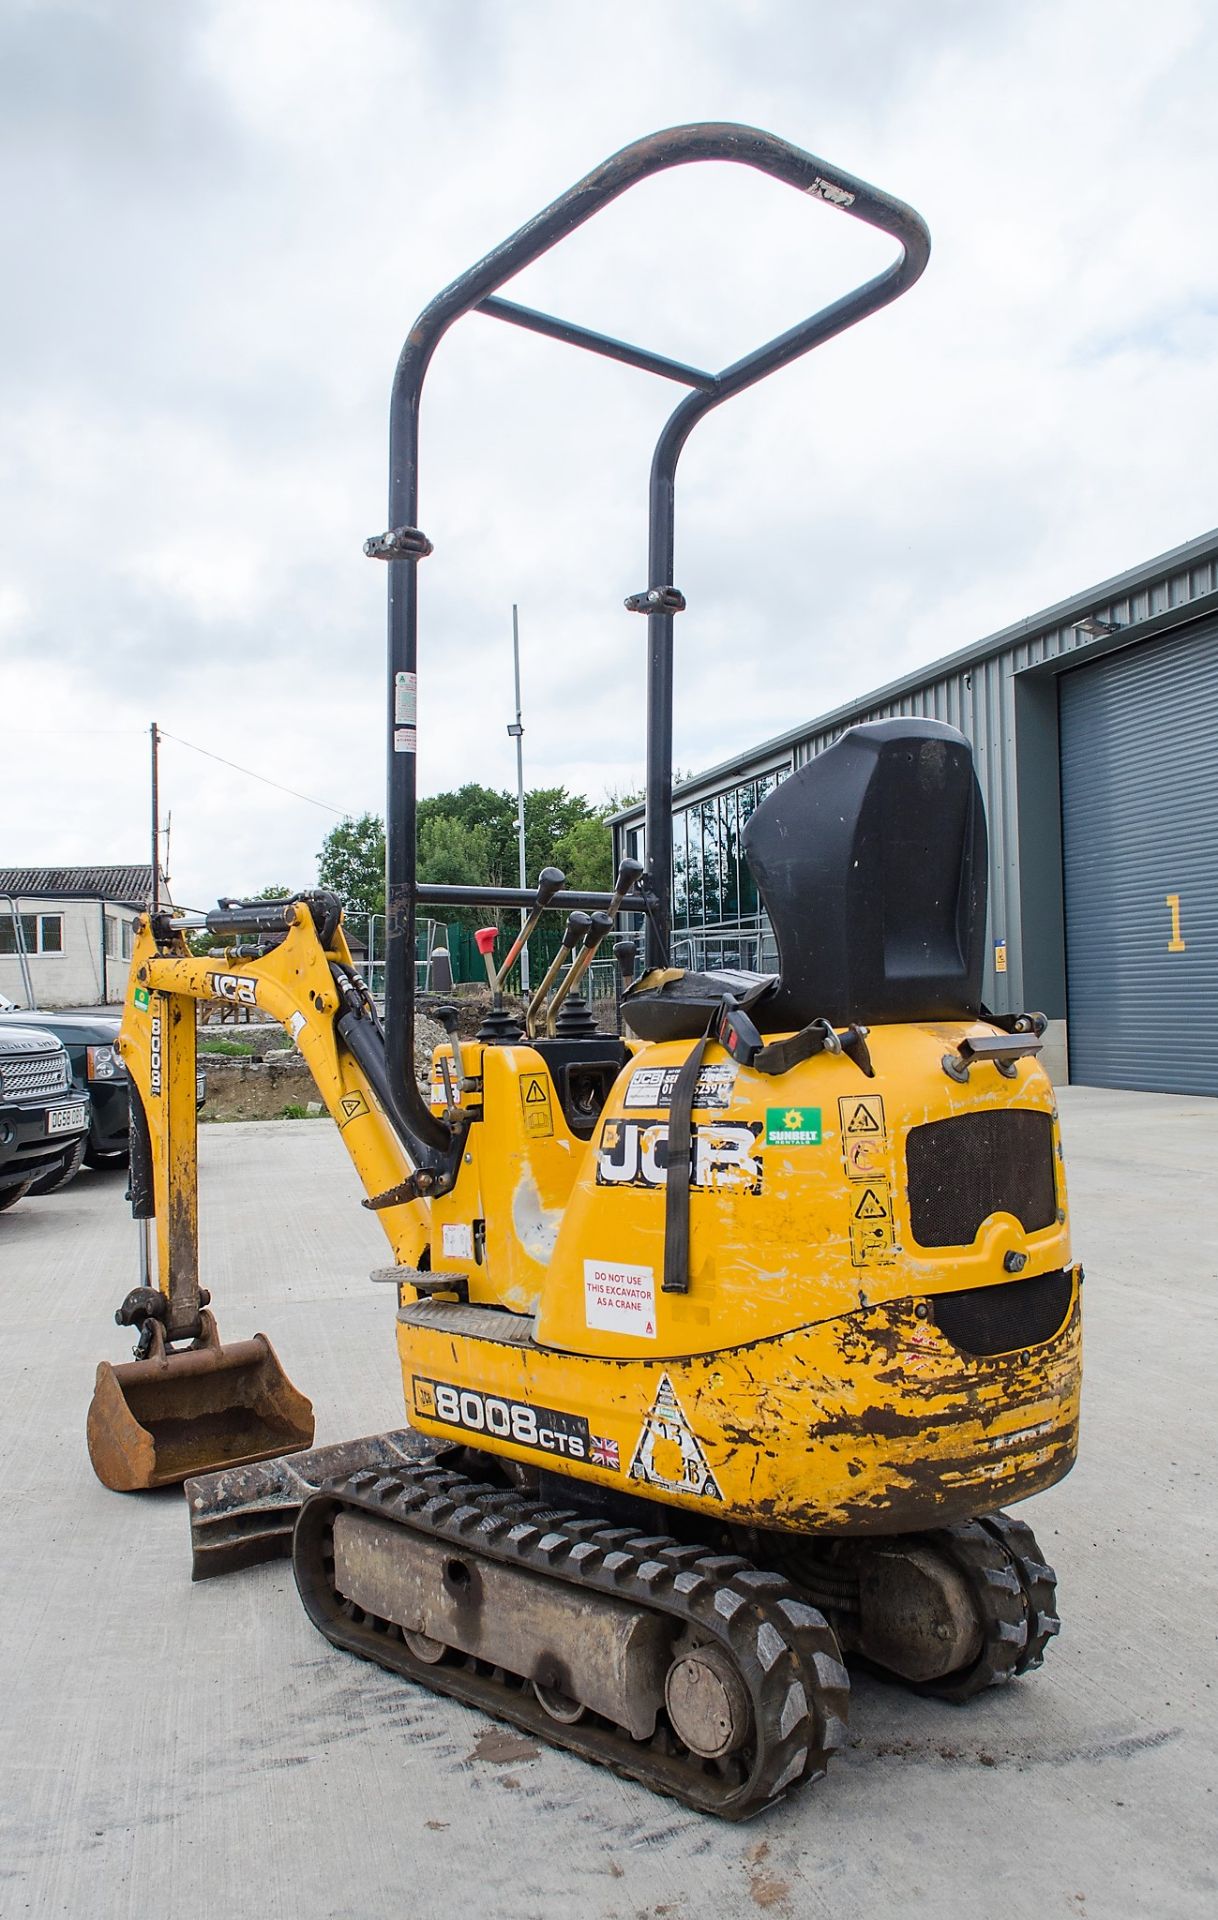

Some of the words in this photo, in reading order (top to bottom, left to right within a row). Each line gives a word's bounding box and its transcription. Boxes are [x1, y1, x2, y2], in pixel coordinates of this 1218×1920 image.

[1166, 895, 1185, 952] 1
[207, 974, 256, 1003] JCB
[151, 1018, 161, 1086] 8008
[633, 1073, 661, 1085] JCB
[52, 1110, 70, 1128] DG58
[768, 1131, 818, 1141] SUNBELT
[600, 1125, 758, 1187] JCB
[594, 1271, 607, 1281] DO
[608, 1273, 625, 1284] NOT
[627, 1276, 642, 1285] USE
[587, 1283, 604, 1294] THIS
[606, 1285, 652, 1300] EXCAVATOR
[597, 1297, 607, 1306] AS
[608, 1299, 614, 1307] A
[615, 1299, 642, 1311] CRANE
